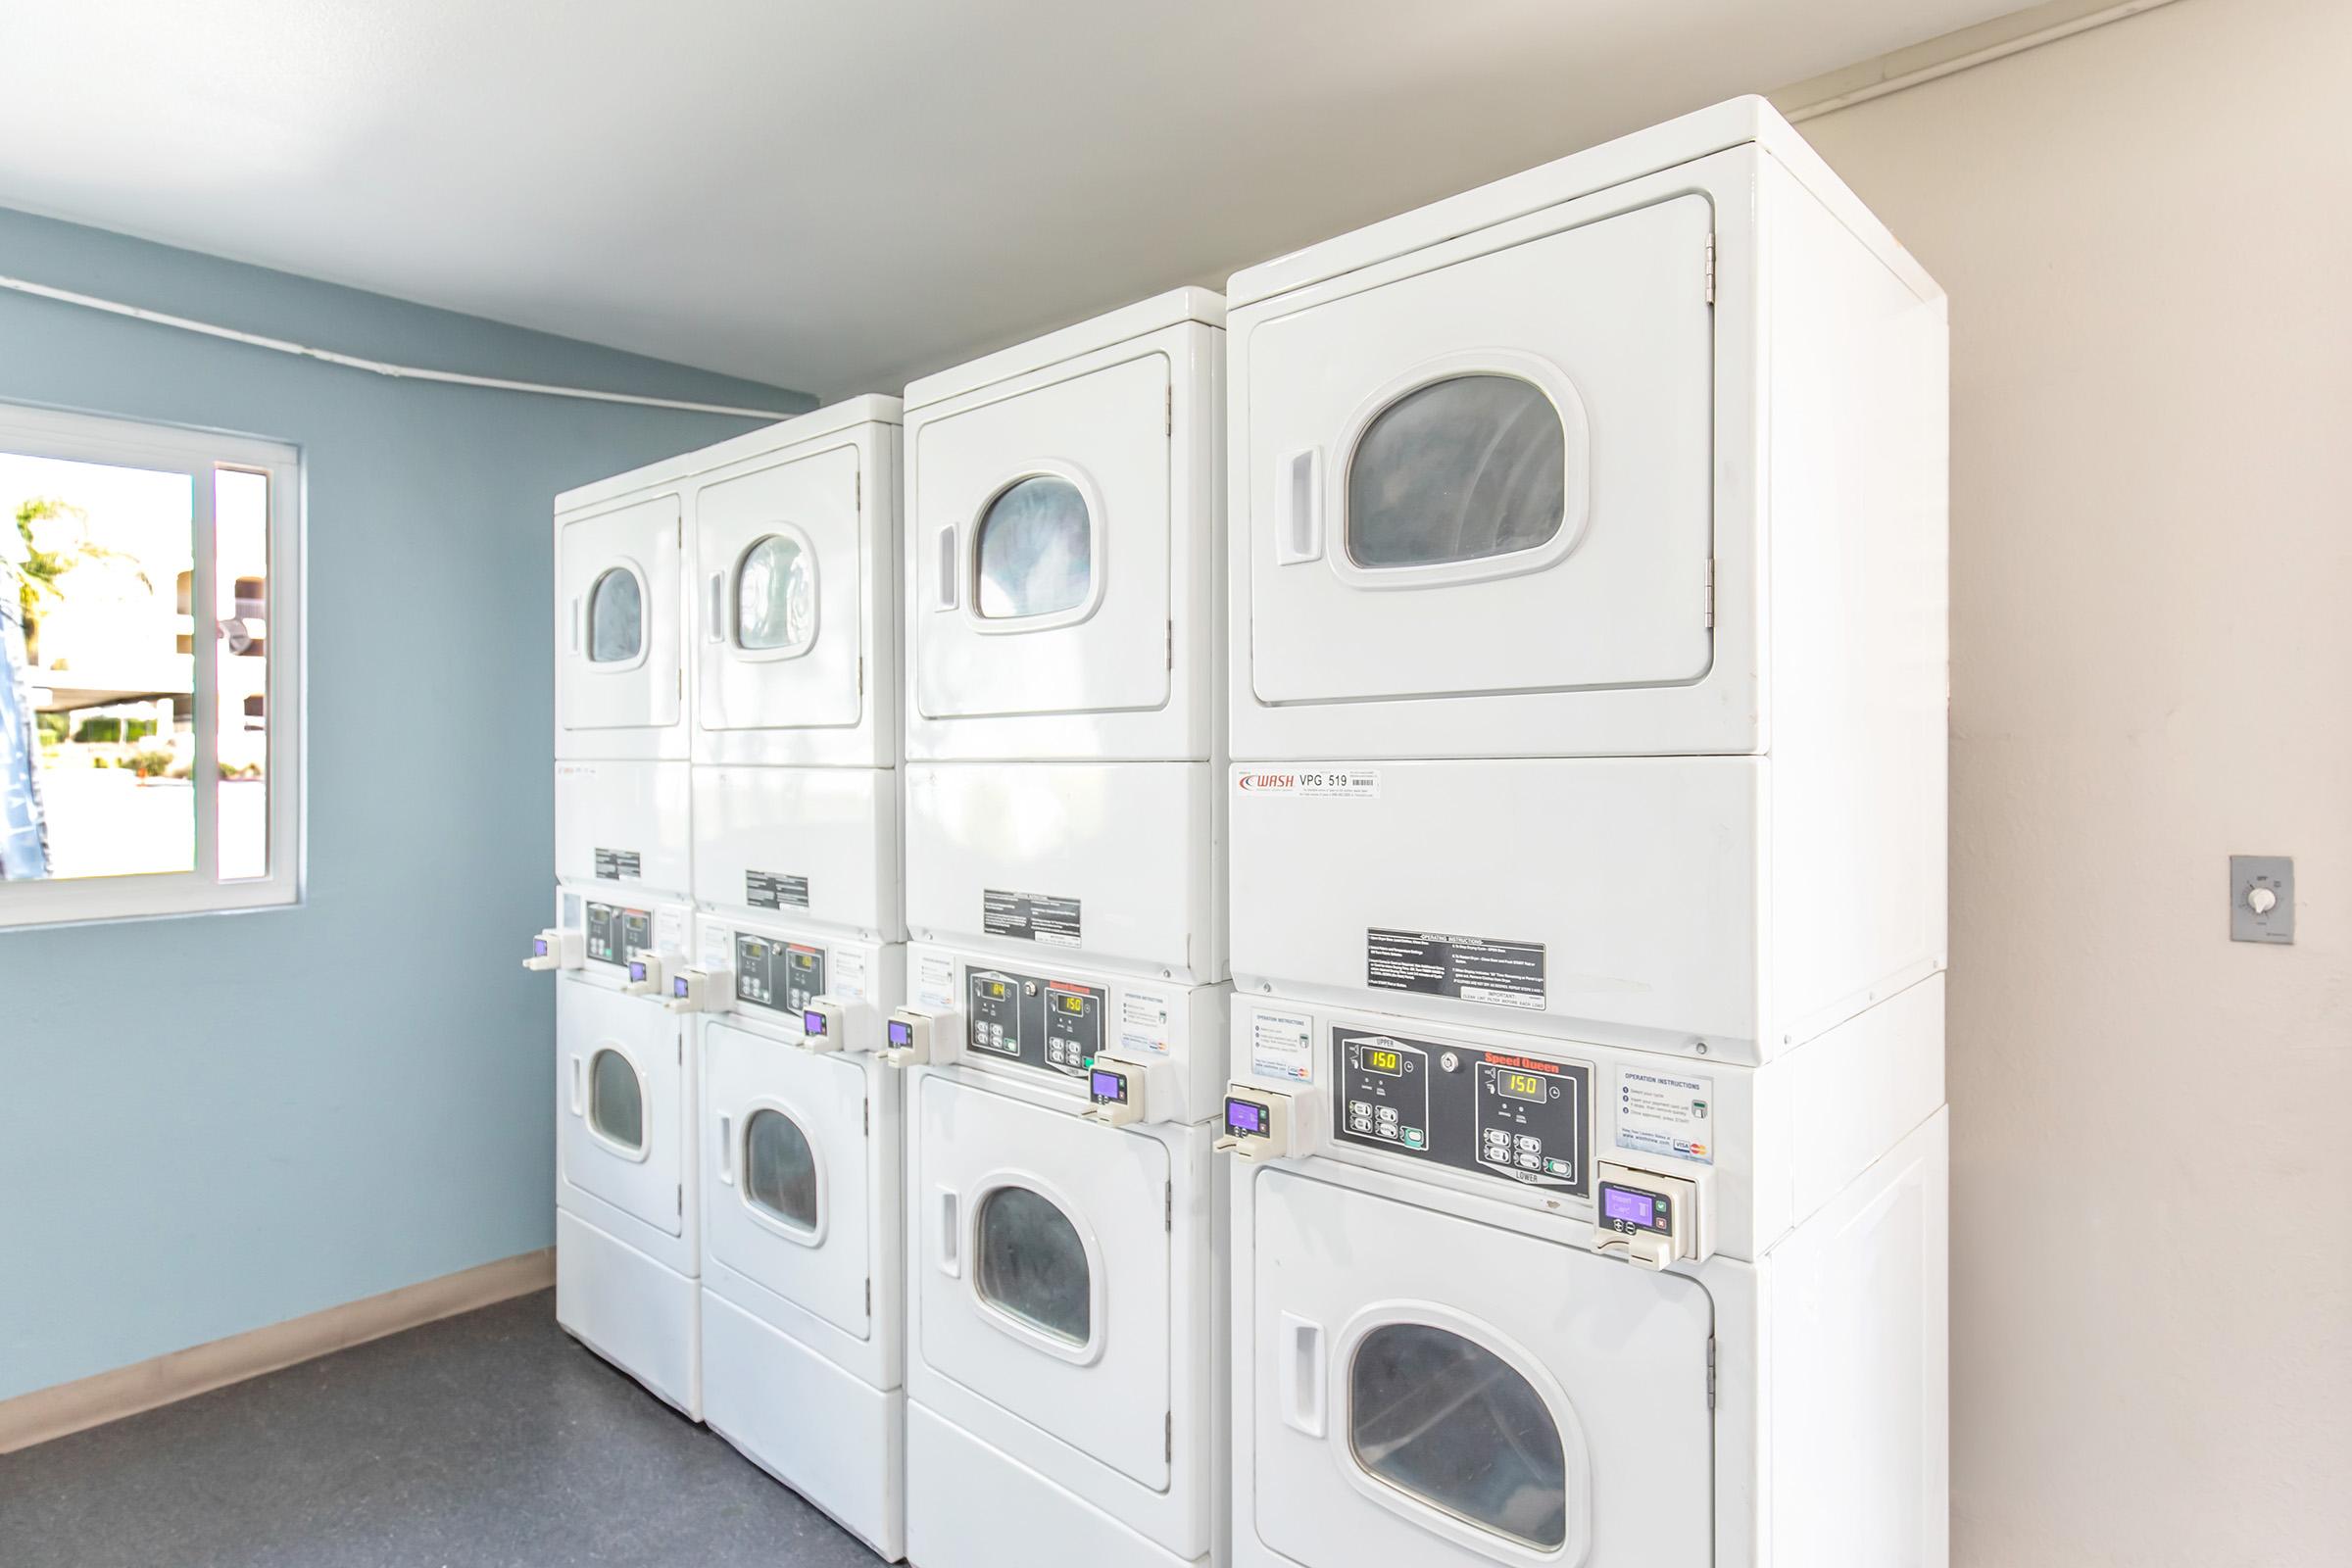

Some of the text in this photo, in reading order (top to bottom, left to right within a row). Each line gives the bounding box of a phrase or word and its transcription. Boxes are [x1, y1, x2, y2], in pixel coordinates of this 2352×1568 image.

[1256, 775, 1294, 788] WASH
[1299, 774, 1323, 786] VPG
[1328, 774, 1348, 787] 519
[1066, 998, 1081, 1011] 150
[1373, 1052, 1396, 1069] 150
[1485, 1052, 1559, 1073] Speed Queen
[1510, 1075, 1537, 1094] 150
[1625, 1072, 1700, 1090] OPERATION INSTRUCTIONS
[1516, 1170, 1538, 1182] LOWER
